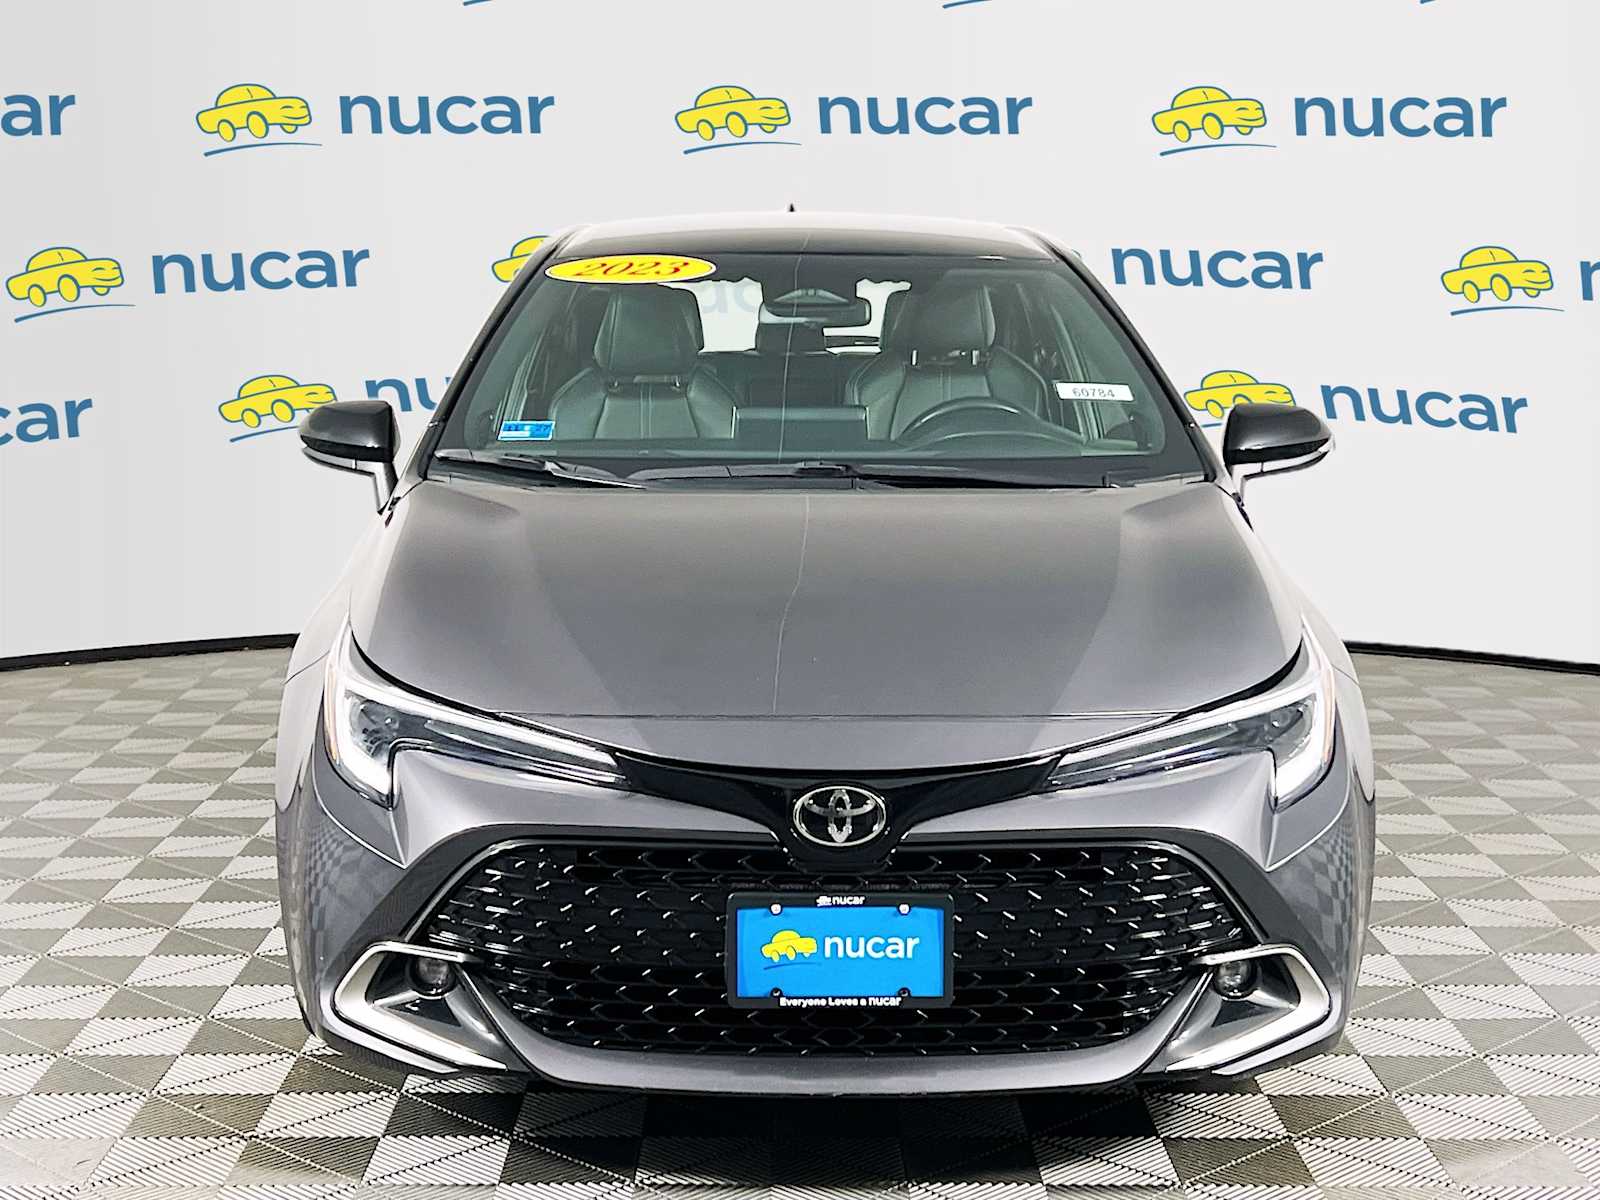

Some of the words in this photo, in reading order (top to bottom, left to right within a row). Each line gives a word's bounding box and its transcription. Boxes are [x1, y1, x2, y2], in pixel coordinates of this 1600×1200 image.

[339, 94, 555, 135] nucar
[819, 95, 1033, 135] nucar
[1294, 96, 1508, 138] nucar
[151, 248, 370, 295] nucar
[574, 261, 690, 277] 2023
[1111, 247, 1324, 290] nucar
[1071, 387, 1116, 398] 60784
[1320, 383, 1529, 434] nucar
[832, 895, 865, 905] nucar
[823, 936, 920, 959] nucar
[779, 997, 827, 1008] Everyone
[828, 997, 858, 1006] Loves
[859, 998, 867, 1006] a
[868, 997, 902, 1006] nucar
